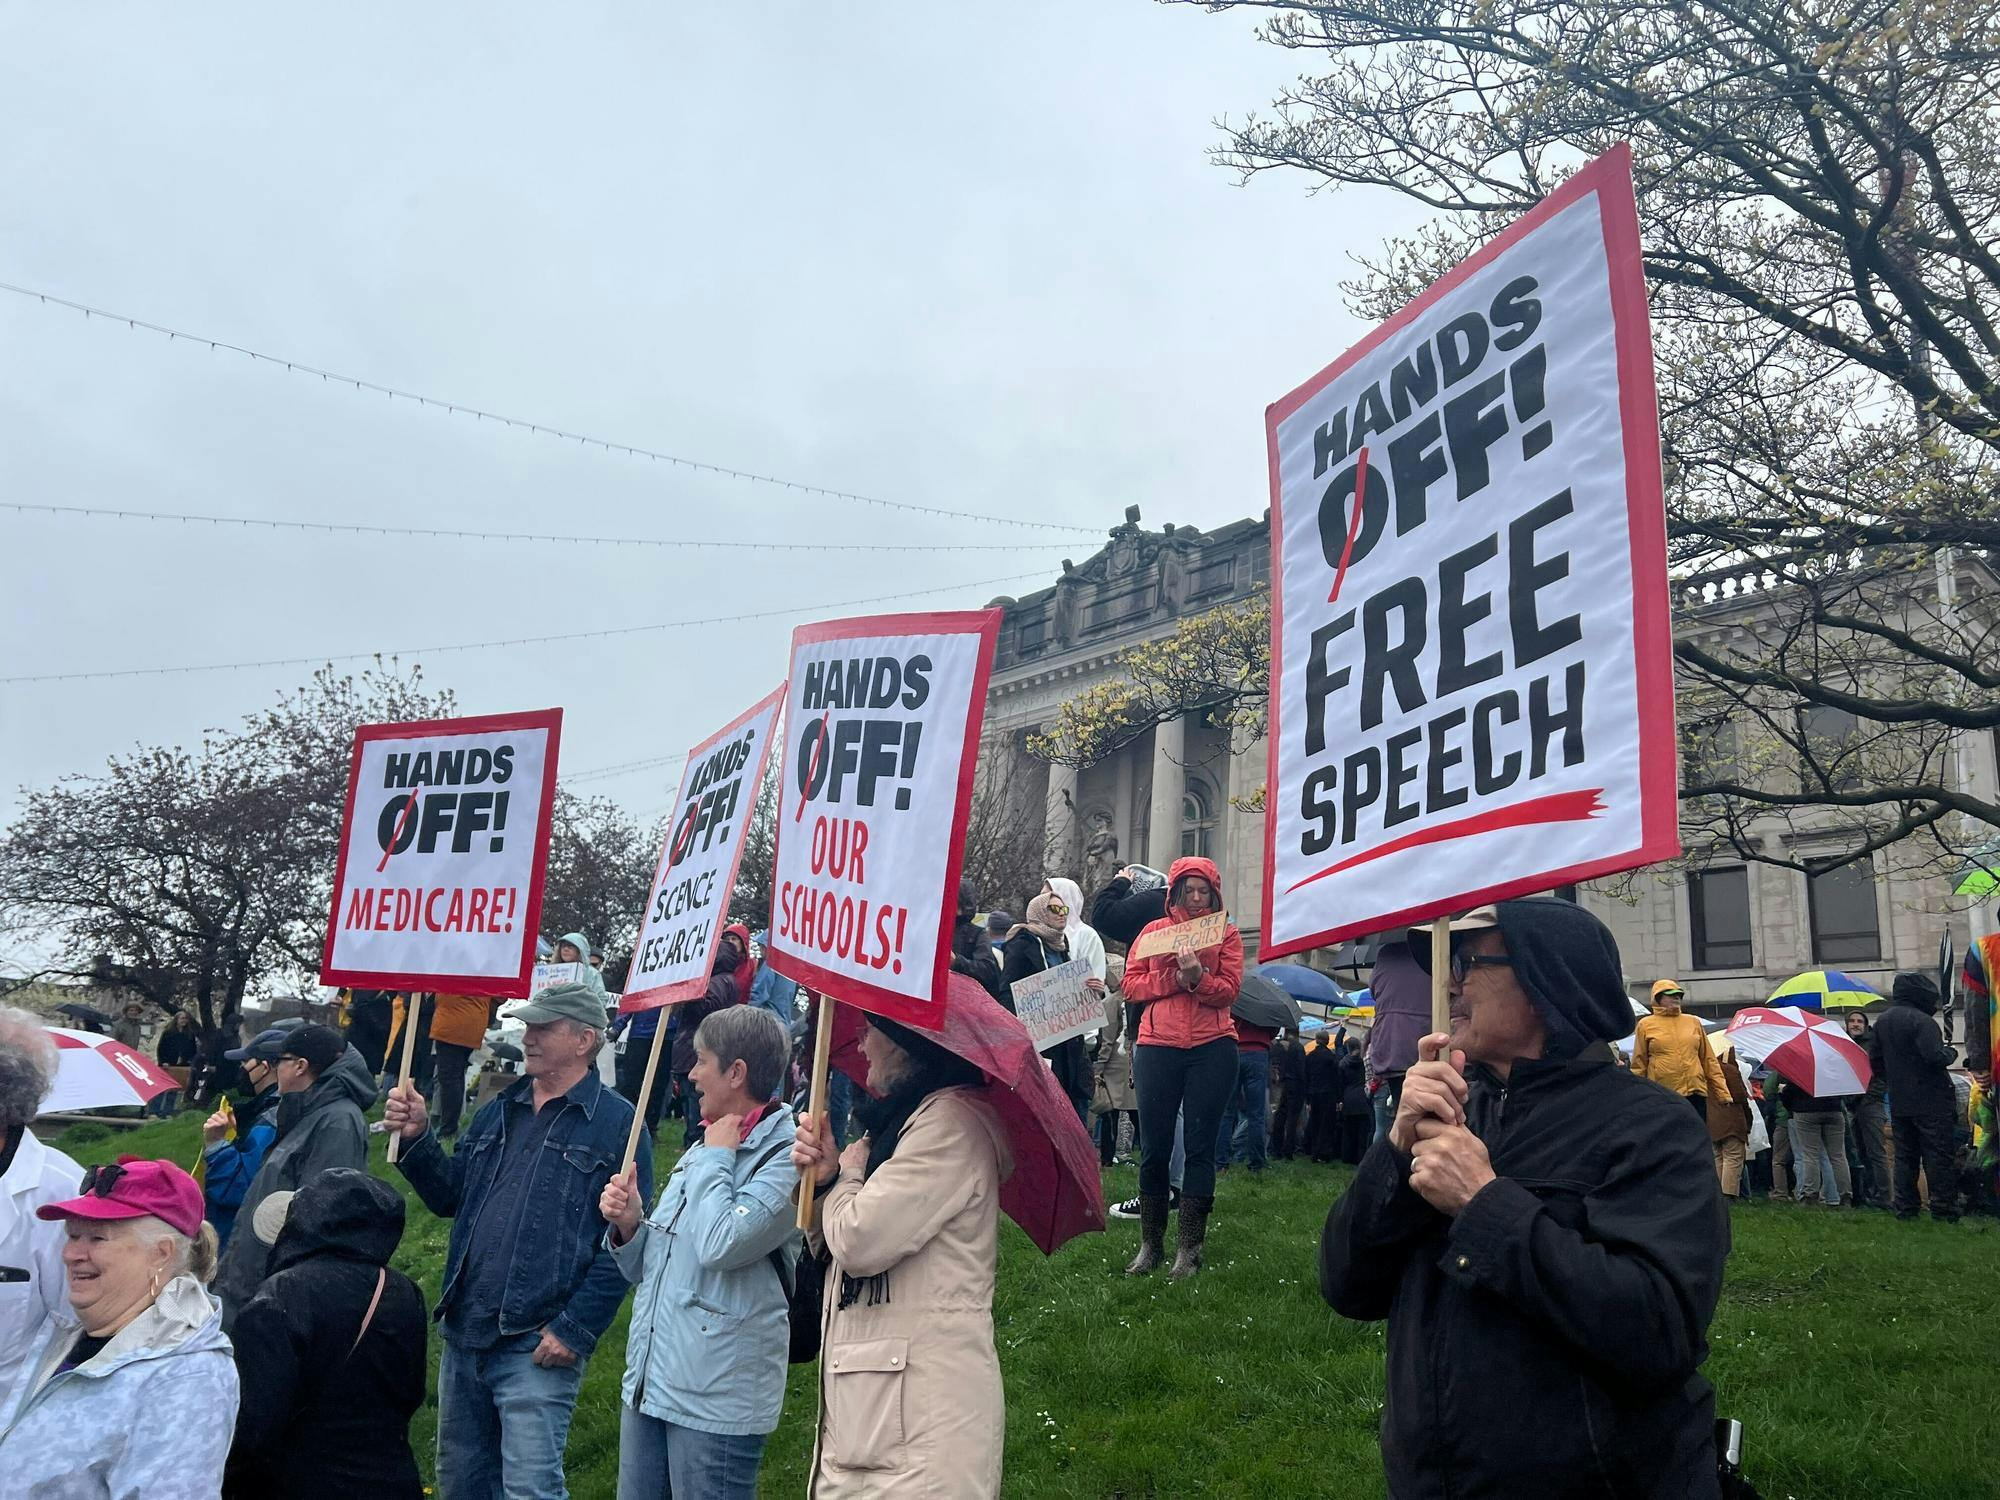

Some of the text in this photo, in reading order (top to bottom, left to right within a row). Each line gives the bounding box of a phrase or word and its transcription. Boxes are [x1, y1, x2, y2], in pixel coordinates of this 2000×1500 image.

[1314, 275, 1542, 480] HANDS
[1318, 343, 1553, 570] OFF!
[1305, 487, 1582, 757] FREE
[803, 655, 932, 711] HANDS
[384, 745, 515, 788] HANDS
[798, 718, 922, 810] OFF!
[1301, 660, 1586, 856] SPEECH
[377, 791, 510, 855] OFF!
[669, 776, 742, 867] OFF!
[811, 815, 868, 884] OUR
[345, 887, 516, 933] MEDICARE!
[652, 868, 717, 923] SCENCE
[780, 881, 907, 975] SCHOOLS!
[1200, 913, 1224, 928] OFF
[1057, 957, 1092, 980] AMERICA
